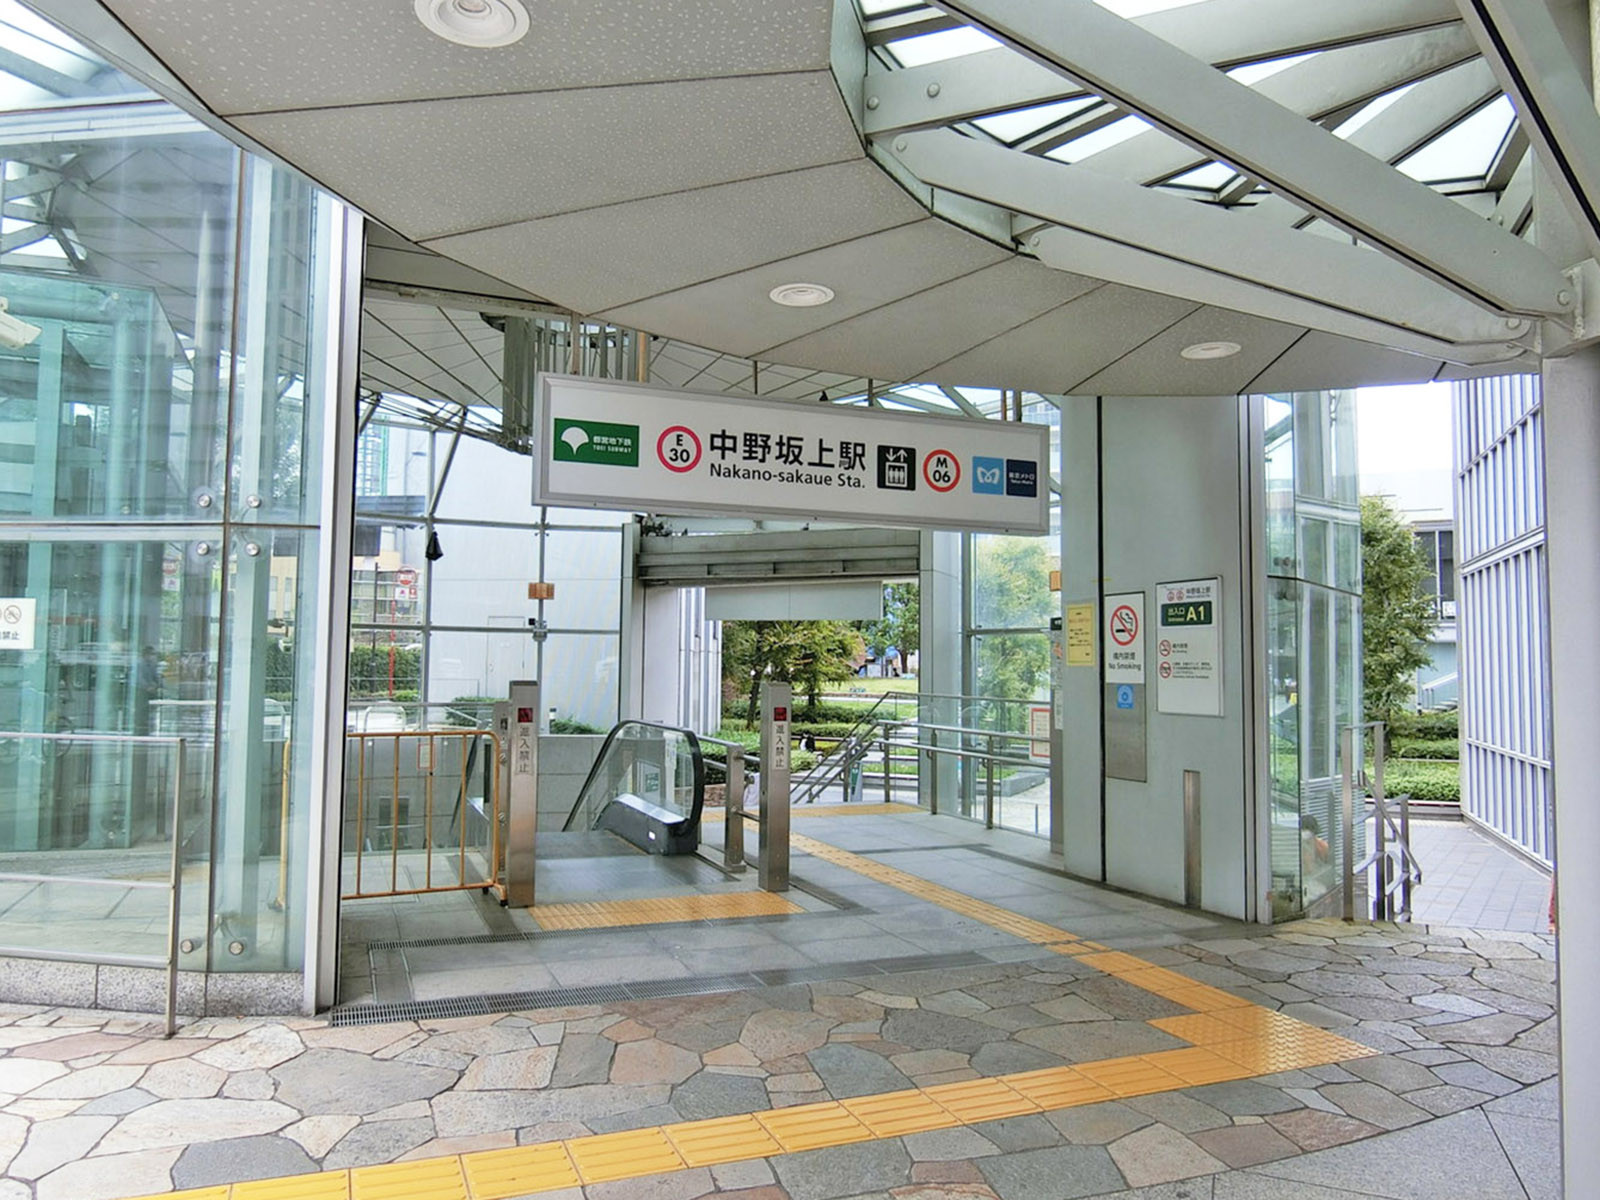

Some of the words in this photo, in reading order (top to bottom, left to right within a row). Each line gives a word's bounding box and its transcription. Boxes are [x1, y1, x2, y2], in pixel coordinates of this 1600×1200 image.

[676, 434, 684, 447] E
[669, 447, 690, 463] 30
[709, 429, 868, 472] 中野坂上駅
[936, 456, 948, 469] M
[710, 462, 835, 486] Nakano-sakaue
[837, 473, 868, 489] Sta.
[932, 469, 951, 484] 06
[1186, 605, 1205, 622] A1
